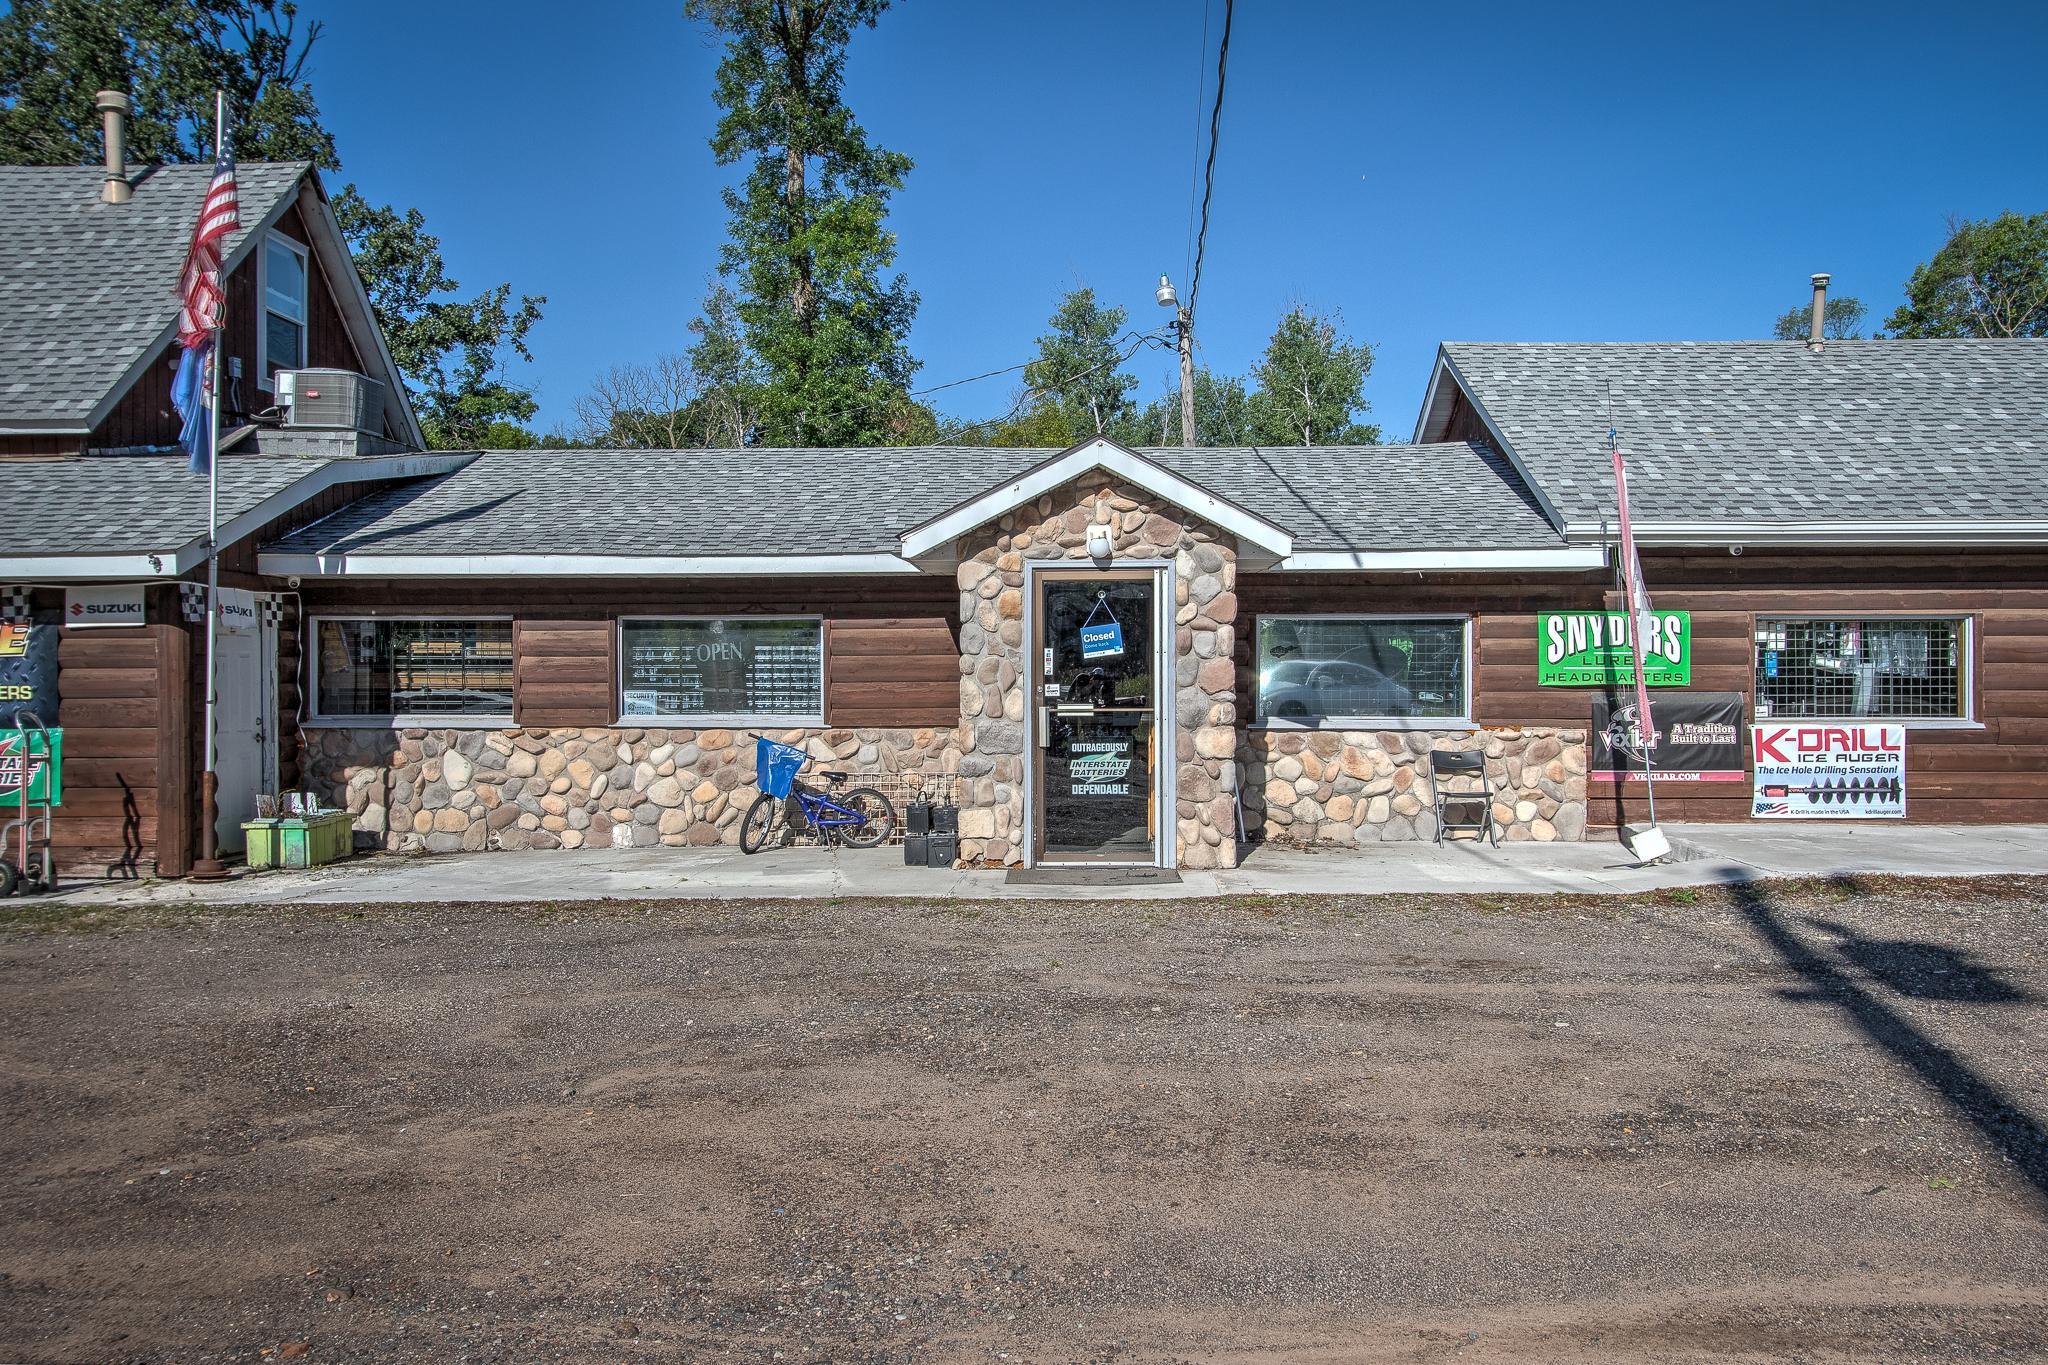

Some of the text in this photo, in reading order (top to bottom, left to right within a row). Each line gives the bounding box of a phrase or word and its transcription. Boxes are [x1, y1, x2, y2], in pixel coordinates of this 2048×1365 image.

[86, 603, 141, 614] SUZUKI
[1083, 630, 1115, 643] Closed
[697, 641, 743, 661] OPEN
[1673, 723, 1736, 733] A Tradition
[1671, 734, 1736, 743] Built to Last
[1071, 742, 1129, 752] OUTRAGEOUSLY
[1755, 728, 1901, 763] K-DRILL
[1798, 753, 1900, 763] ICE AUGER
[1758, 765, 1898, 776] The Ice Hole Drilling Sensation!
[1071, 784, 1129, 795] DEPENDABLE
